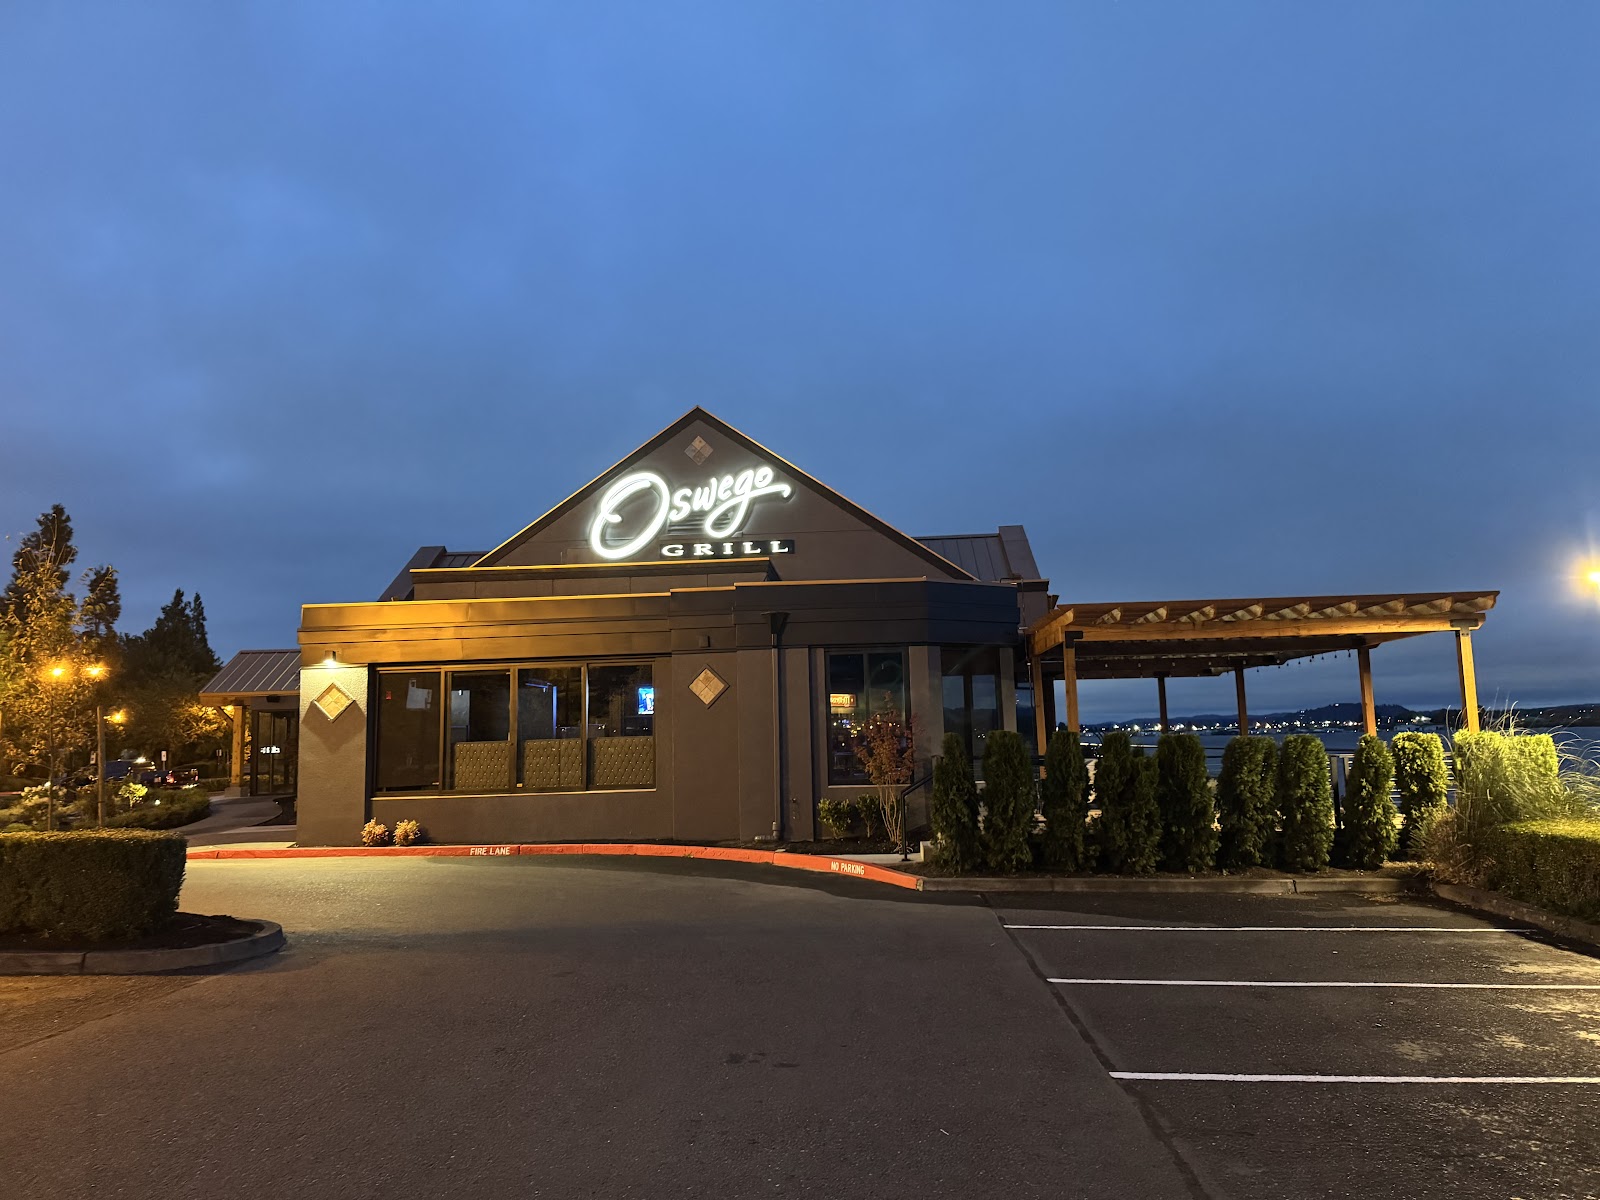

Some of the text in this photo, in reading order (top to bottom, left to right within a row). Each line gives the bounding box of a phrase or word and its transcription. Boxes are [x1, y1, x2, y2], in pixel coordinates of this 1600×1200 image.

[590, 466, 792, 560] Oswego
[661, 540, 789, 557] GRILL
[469, 846, 511, 856] FIRE LANE
[830, 861, 865, 875] NO PARKING
